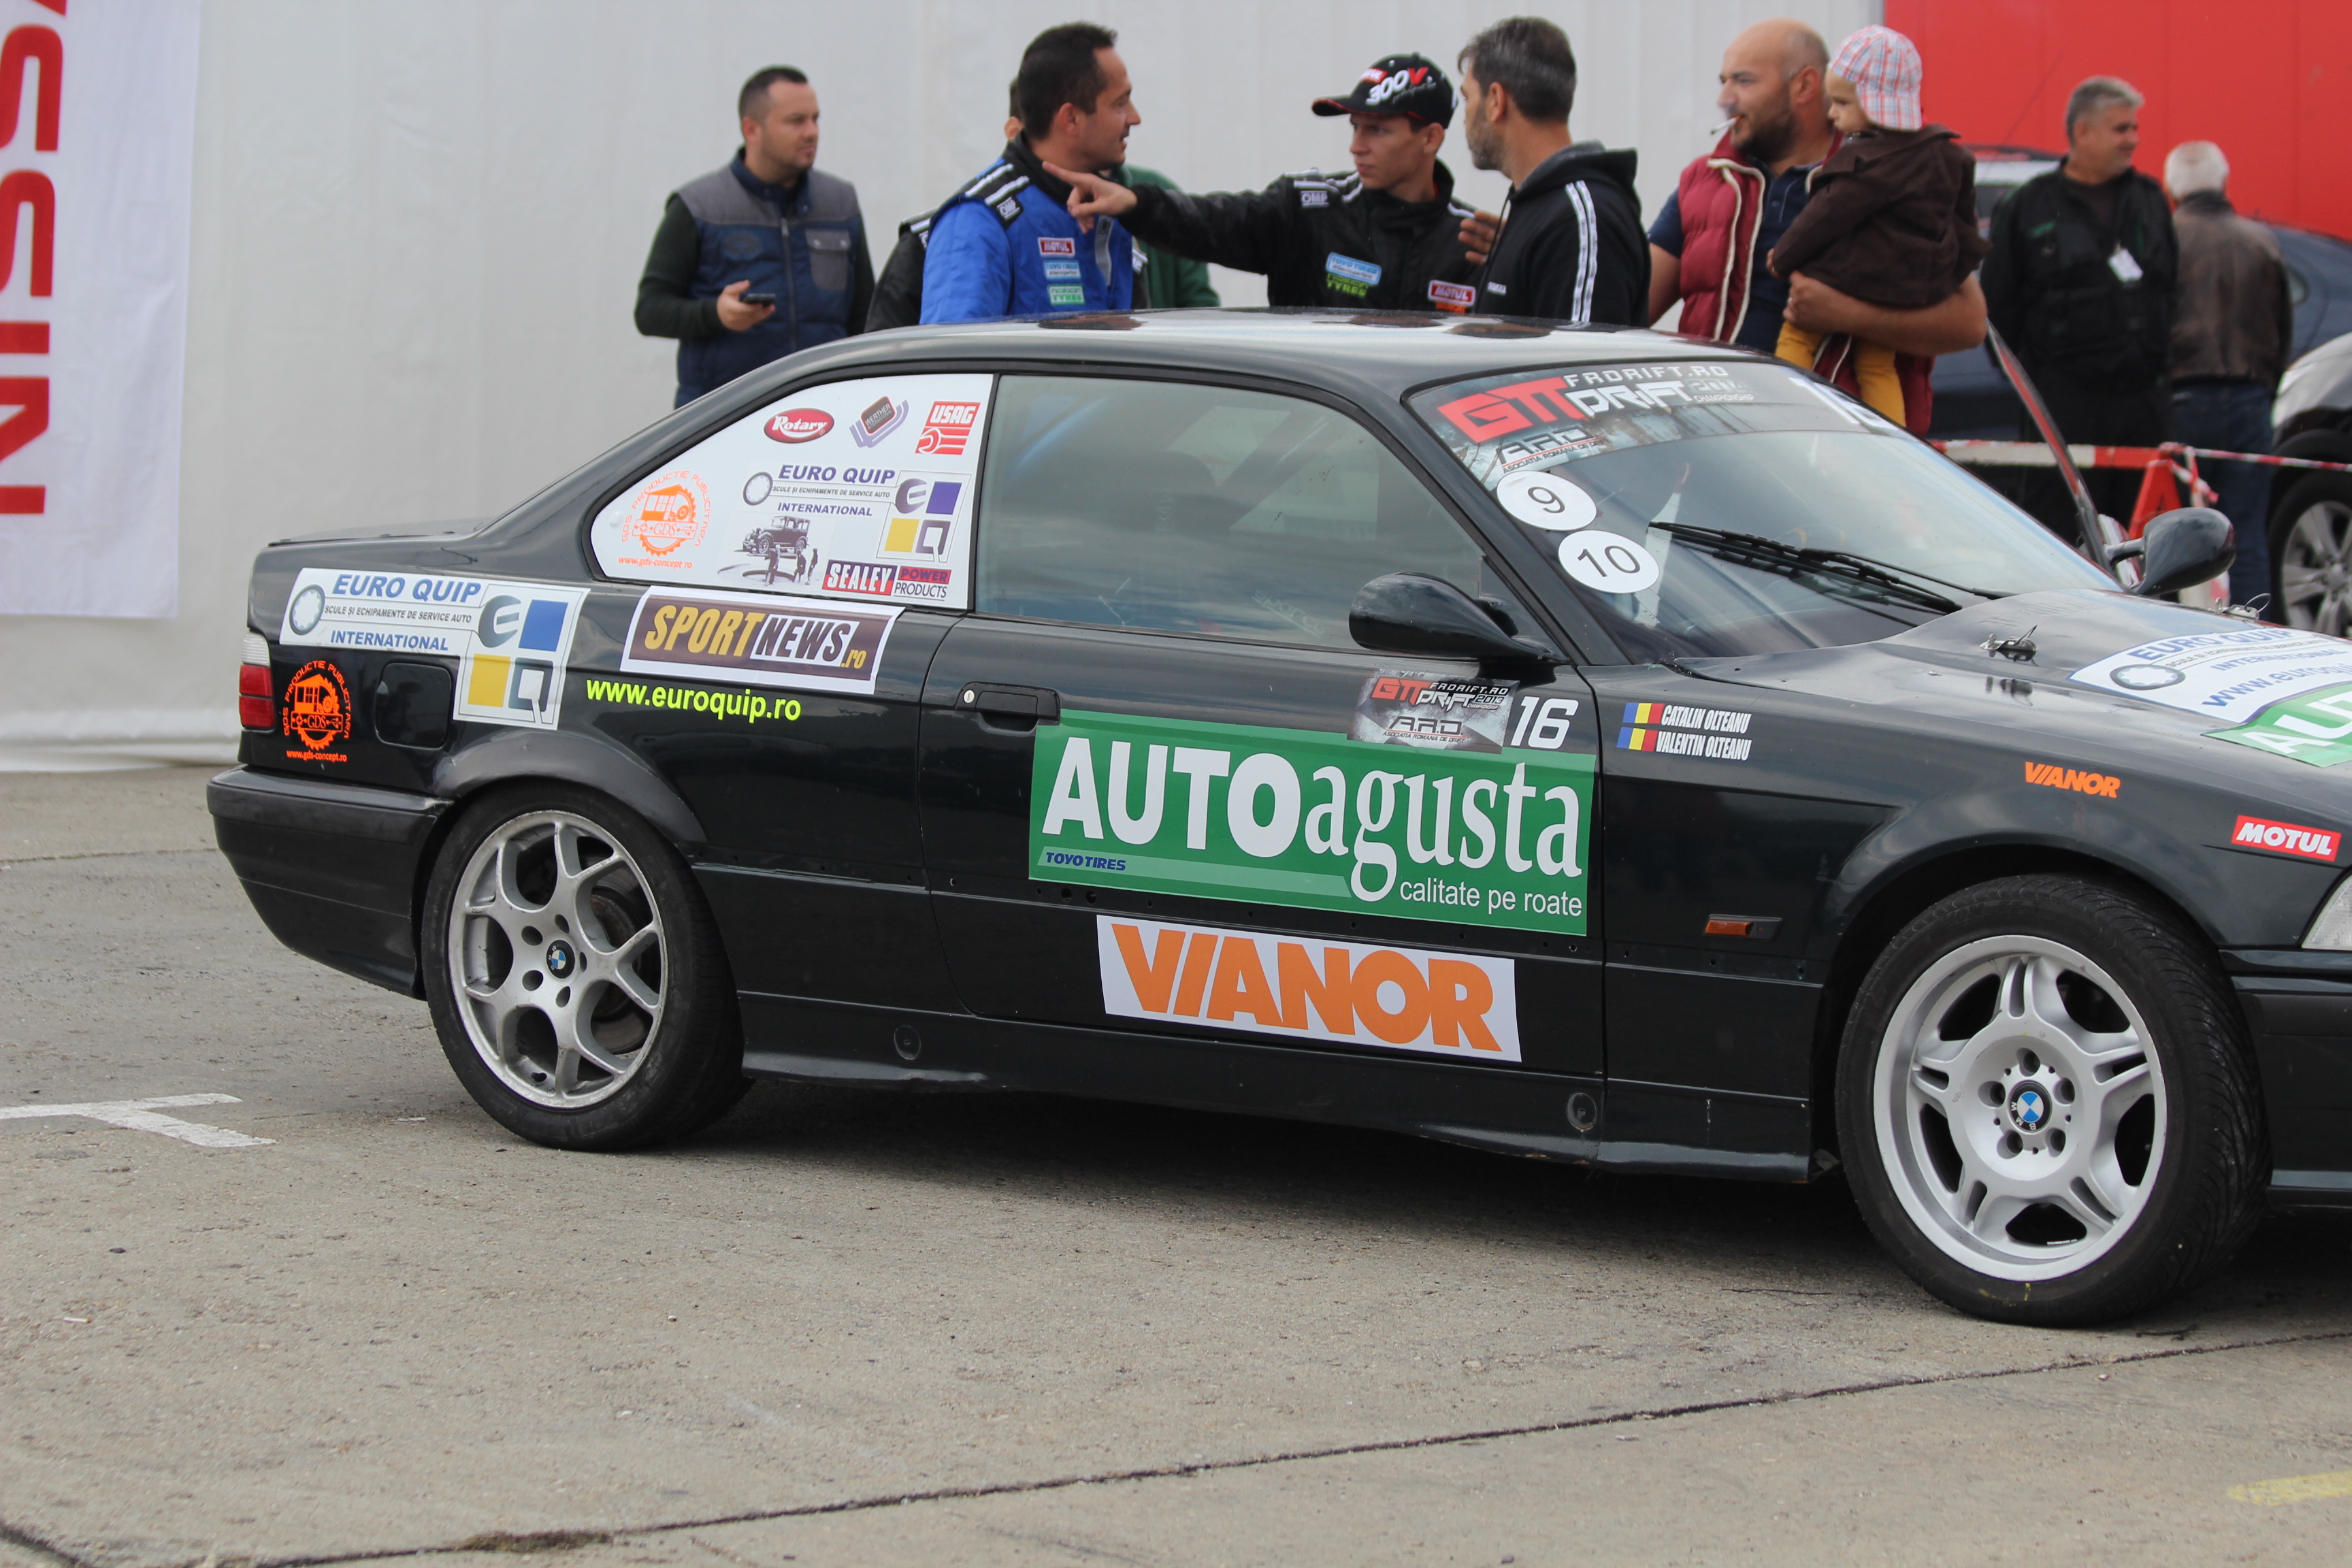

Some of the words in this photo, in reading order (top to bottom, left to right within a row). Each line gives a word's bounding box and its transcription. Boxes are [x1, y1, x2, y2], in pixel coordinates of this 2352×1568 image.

[1365, 67, 1428, 105] 300V
[1301, 193, 1328, 203] OMP
[0, 0, 67, 514] NISS
[1043, 242, 1071, 252] MOTUL
[1332, 257, 1353, 267] TOYO
[1327, 281, 1367, 298] TYRES
[1434, 286, 1469, 300] MOTUL
[1565, 380, 1693, 414] DRIFT
[1693, 393, 1754, 403] CHAMPIONSHIP
[772, 415, 828, 433] Rotary
[865, 403, 891, 425] WERTHER
[930, 405, 977, 424] USAG
[1503, 456, 1542, 474] ASOCIATIA
[1544, 446, 1578, 459] ROMANA
[778, 464, 836, 481] EURO
[843, 468, 896, 485] QUIP
[632, 470, 690, 510] PRODUCTIE
[798, 487, 838, 495] ECHIPAMENTE
[1526, 486, 1566, 514] 9
[777, 502, 872, 516] INTERNATIONAL
[653, 522, 677, 536] GDS
[1577, 545, 1641, 578] 10
[827, 563, 892, 593] SEALEY
[900, 568, 948, 582] POWER
[331, 574, 406, 598] EURO
[412, 578, 482, 602] QUIP
[894, 582, 947, 598] PRODUCTS
[324, 605, 347, 615] SCULE
[356, 607, 405, 619] ECHIPAMENTE
[407, 610, 417, 619] DE
[418, 612, 450, 621] SERVICE
[451, 614, 472, 623] AUTO
[1254, 590, 1326, 635] sparco
[330, 630, 449, 651] INTERNATIONAL
[2127, 636, 2224, 661] EURO
[2219, 628, 2294, 644] QUIP
[2210, 649, 2349, 671] INTERNATIONAL
[284, 660, 327, 702] PRODUCTIE
[327, 663, 353, 739] PUBLICITARA
[586, 679, 802, 723] www.euroquip.ro
[1415, 690, 1476, 712] DRIFT
[1475, 694, 1504, 704] 2013
[307, 715, 327, 729] GDS
[1510, 696, 1580, 749] 16
[1661, 704, 1706, 729] CATALIN
[1703, 709, 1752, 734] OLTEANU
[2241, 691, 2352, 754] AU
[1382, 731, 1411, 739] ASOCIATIA
[1411, 734, 1439, 742] ROMANA
[1655, 731, 1707, 756] VALENTIN
[1705, 736, 1752, 761] OLTEANU
[287, 750, 348, 762] www.gds-concept.ro
[2025, 762, 2121, 798] VIANOR
[2236, 822, 2333, 855] MOTUL
[1046, 852, 1083, 866] TOYO
[1085, 856, 1126, 871] TIRES
[1399, 877, 1480, 909] calitate
[1487, 887, 1516, 916] pe
[1524, 891, 1583, 918] roate
[1111, 923, 1503, 1052] VIANOR
[2011, 1101, 2037, 1130] BMW
